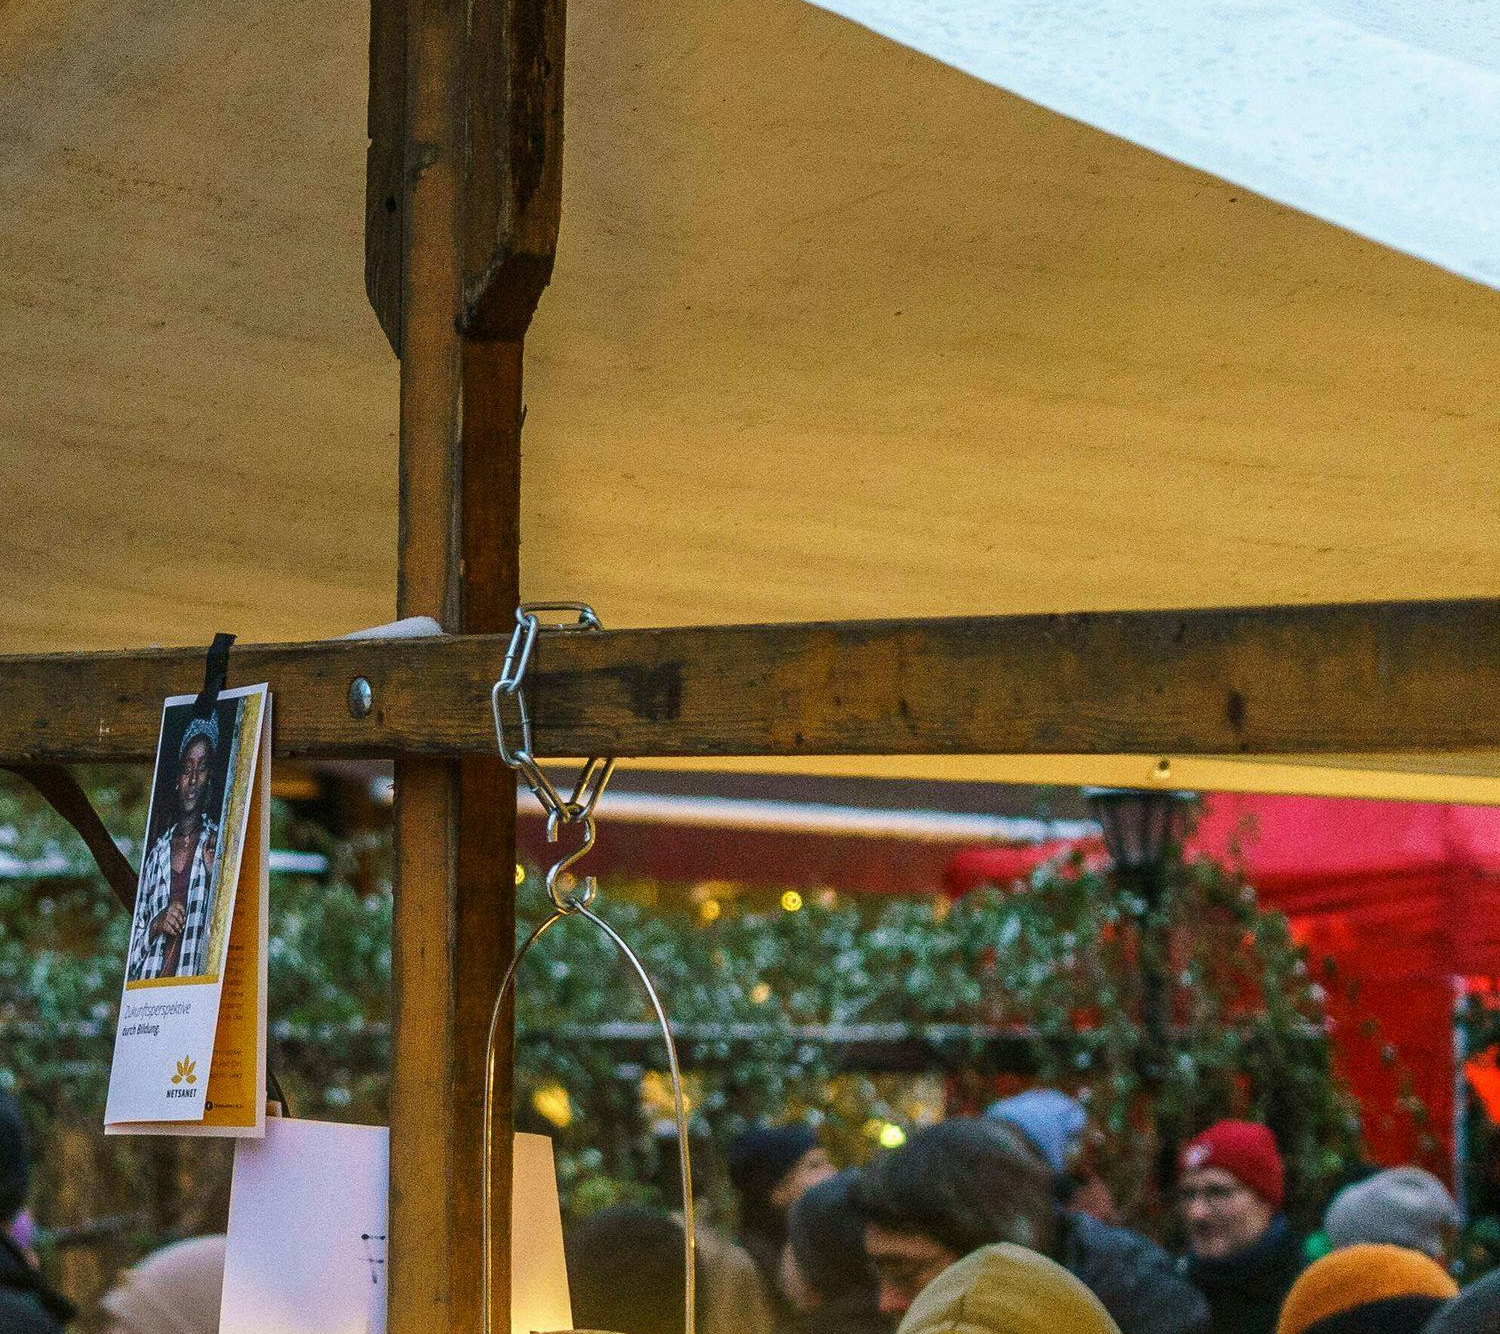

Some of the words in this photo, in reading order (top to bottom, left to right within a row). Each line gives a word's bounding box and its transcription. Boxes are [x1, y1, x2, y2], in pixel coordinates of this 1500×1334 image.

[124, 1001, 192, 1021] Zukunftsperspektive
[122, 1025, 136, 1036] durch
[166, 1088, 197, 1098] NETSANET
